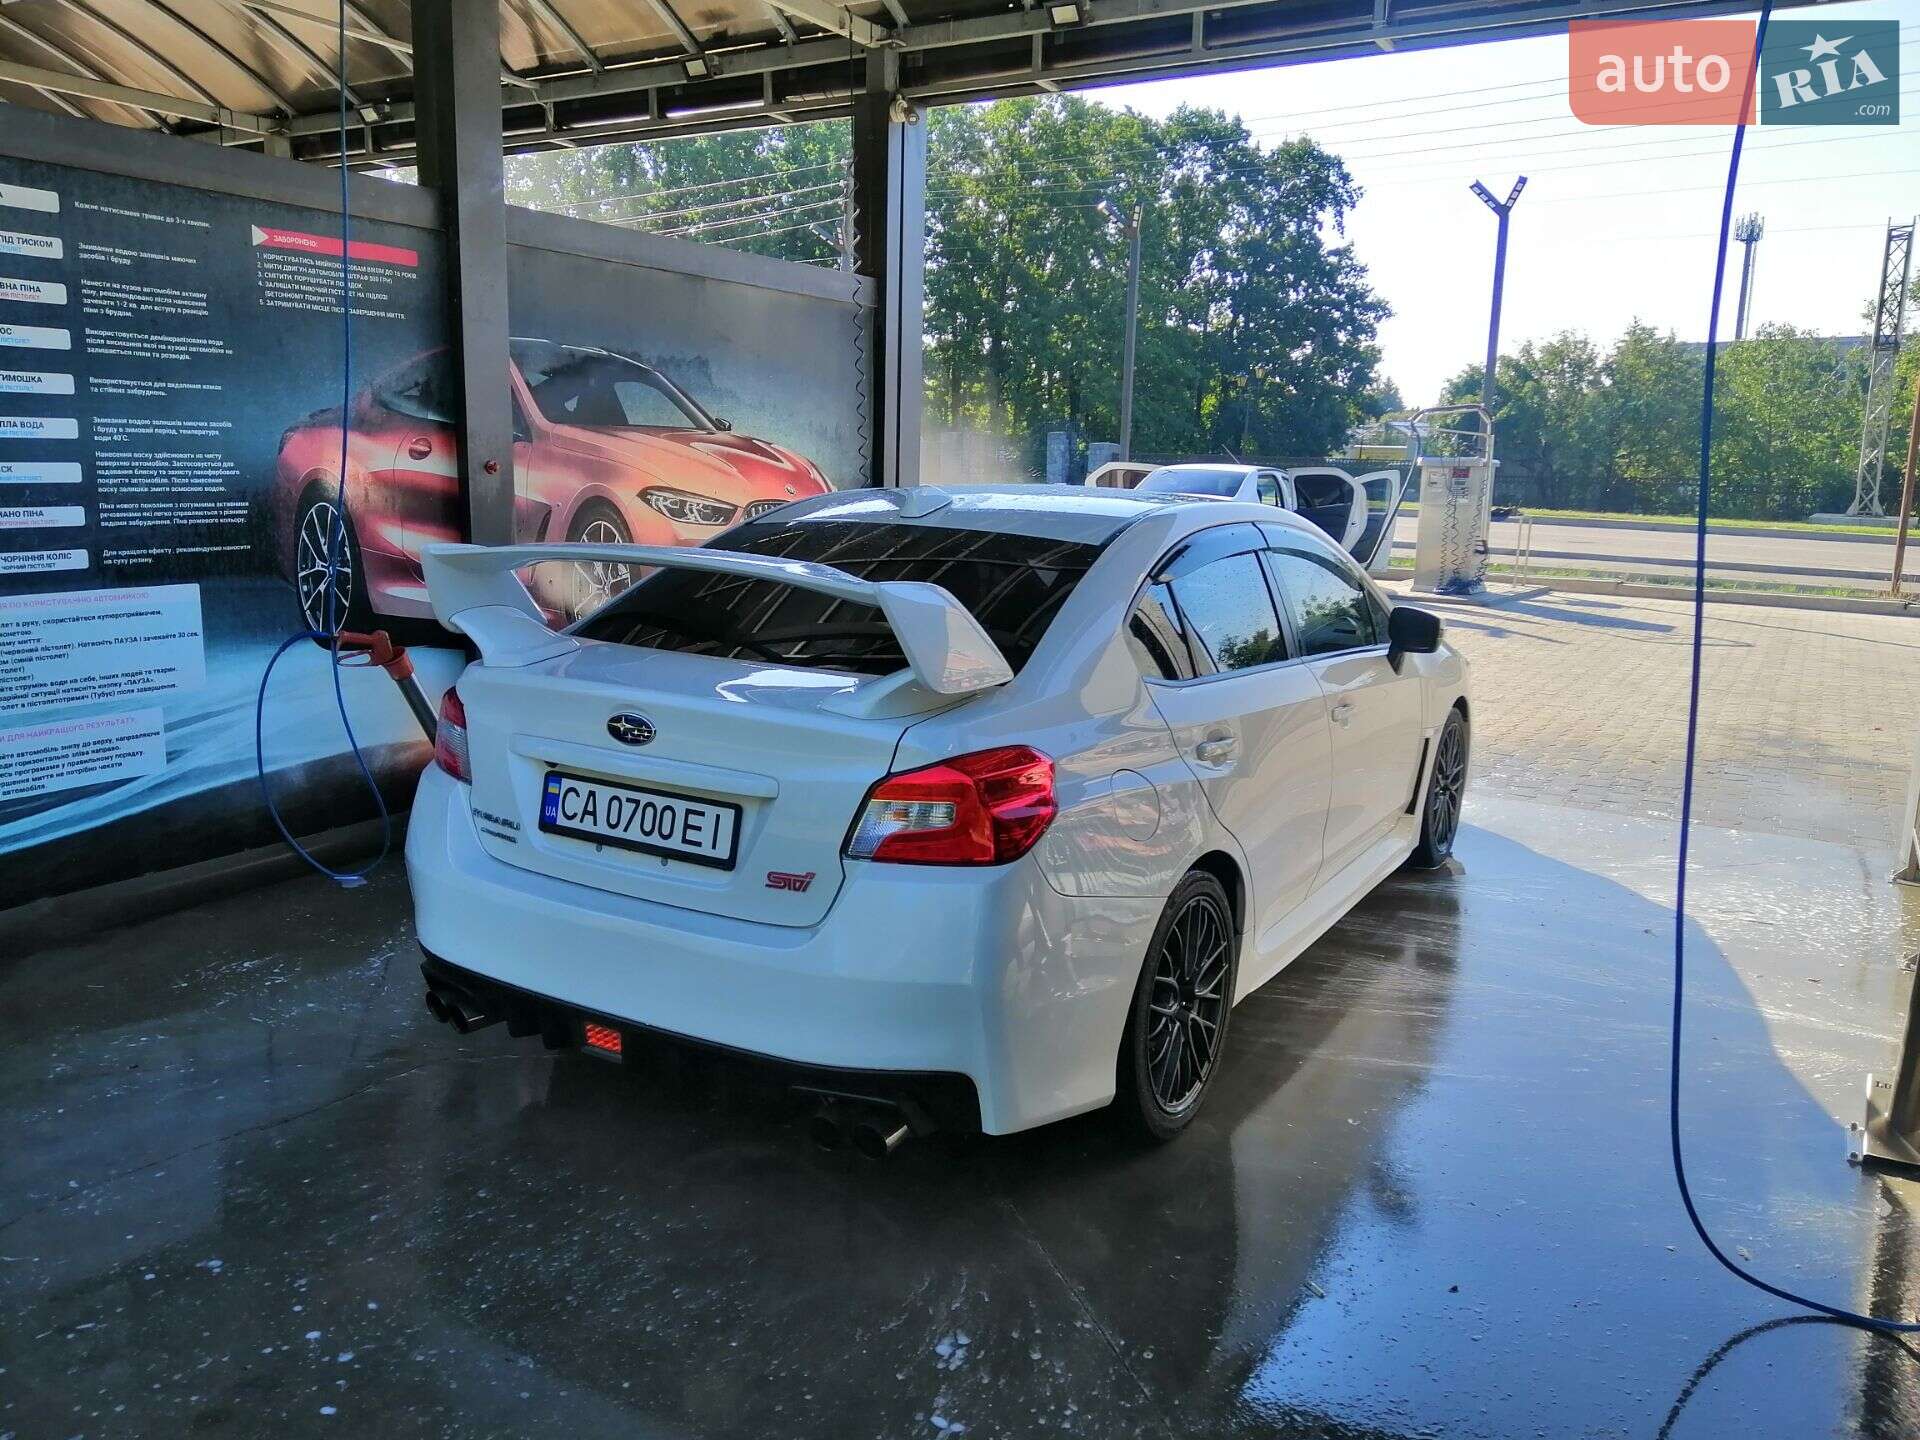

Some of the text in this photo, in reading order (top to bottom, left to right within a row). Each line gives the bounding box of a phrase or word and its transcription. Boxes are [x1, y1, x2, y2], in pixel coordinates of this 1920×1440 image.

[74, 201, 98, 211] Кожне
[17, 237, 53, 248] ТИСКОМ
[79, 252, 105, 261] засобів
[115, 248, 137, 257] водою
[264, 262, 282, 271] МИТИ
[347, 272, 368, 281] ШТРАФ
[20, 284, 41, 293] ПІНА
[81, 278, 110, 288] Нанести
[122, 284, 141, 293] кузов
[143, 285, 180, 295] автомобіля
[182, 290, 207, 300] активну
[82, 298, 114, 306] зачекати
[100, 291, 153, 303] рекомендовано
[155, 295, 172, 303] після
[0, 327, 12, 335] ОС
[85, 328, 148, 341] Використовується
[86, 336, 105, 345] після
[20, 421, 44, 429] ВОДА
[97, 425, 117, 434] бруду
[1, 465, 13, 473] СК
[22, 510, 44, 518] ПІНА
[0, 552, 72, 563] ЧОРНІННЯ КОЛІС
[22, 618, 40, 628] руку,
[43, 612, 96, 626] скористайтеся
[114, 635, 137, 644] ПАУЗА
[36, 651, 68, 664] пістолет)
[50, 678, 68, 687] води
[80, 673, 97, 684] себе,
[99, 670, 119, 680] інших
[121, 668, 143, 679] людей
[30, 686, 60, 699] ситуації
[98, 680, 122, 691] кнопку
[117, 686, 135, 696] після
[7, 731, 26, 742] ДЛЯ
[16, 743, 59, 757] автомобіль
[60, 742, 80, 753] знизу
[15, 752, 69, 768] горизонтально
[71, 747, 90, 758] зліва
[14, 763, 60, 778] програмами
[66, 755, 113, 770] правильному
[99, 760, 123, 770] чекати
[545, 805, 558, 818] UA
[561, 786, 722, 850] CA 0700 EI
